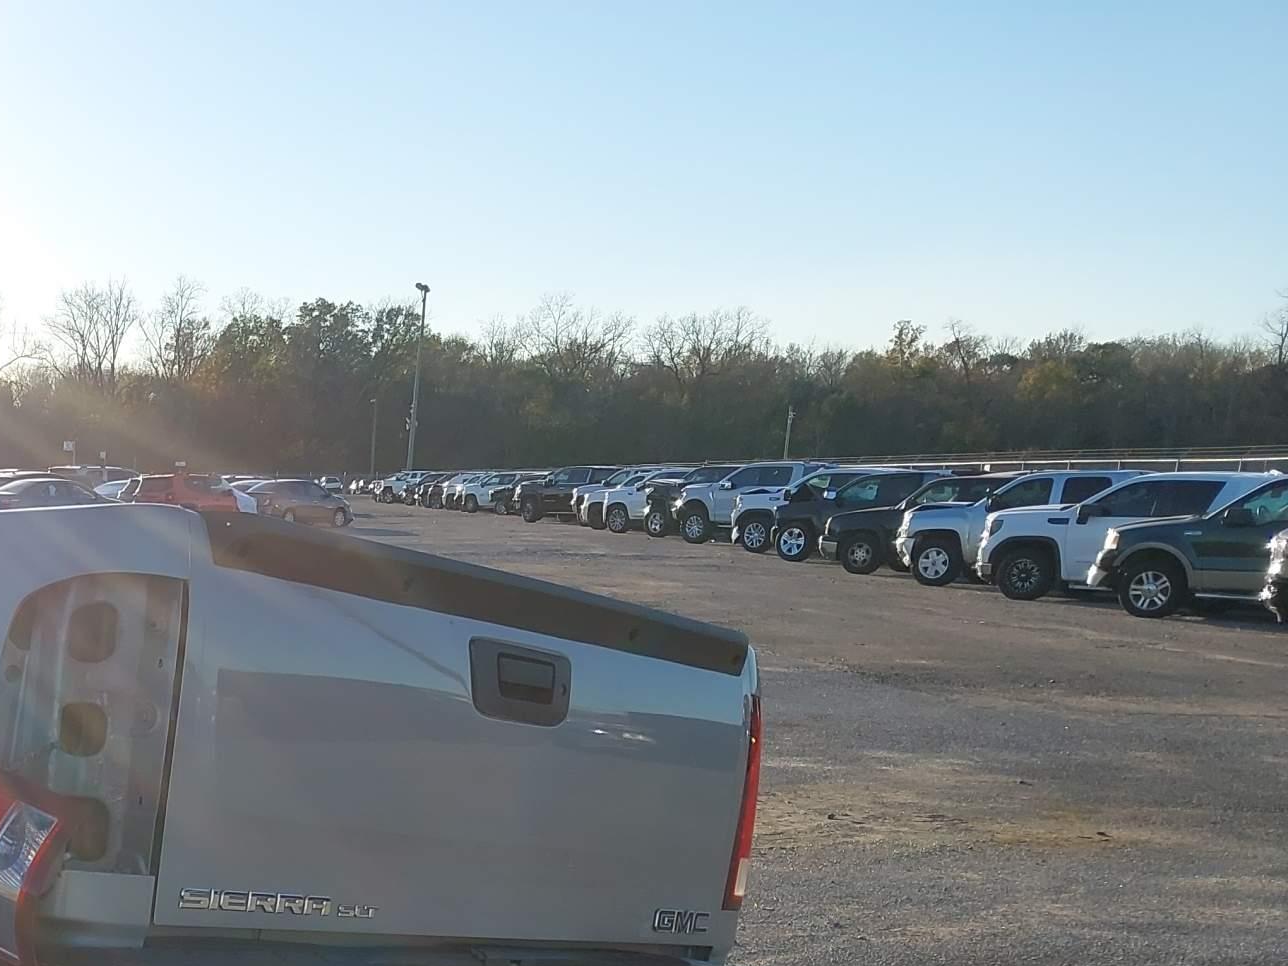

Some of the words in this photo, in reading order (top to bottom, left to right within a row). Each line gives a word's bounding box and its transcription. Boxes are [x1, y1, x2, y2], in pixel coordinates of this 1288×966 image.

[178, 887, 332, 916] SIERRA
[337, 904, 380, 919] SLT
[652, 908, 711, 934] GMC
